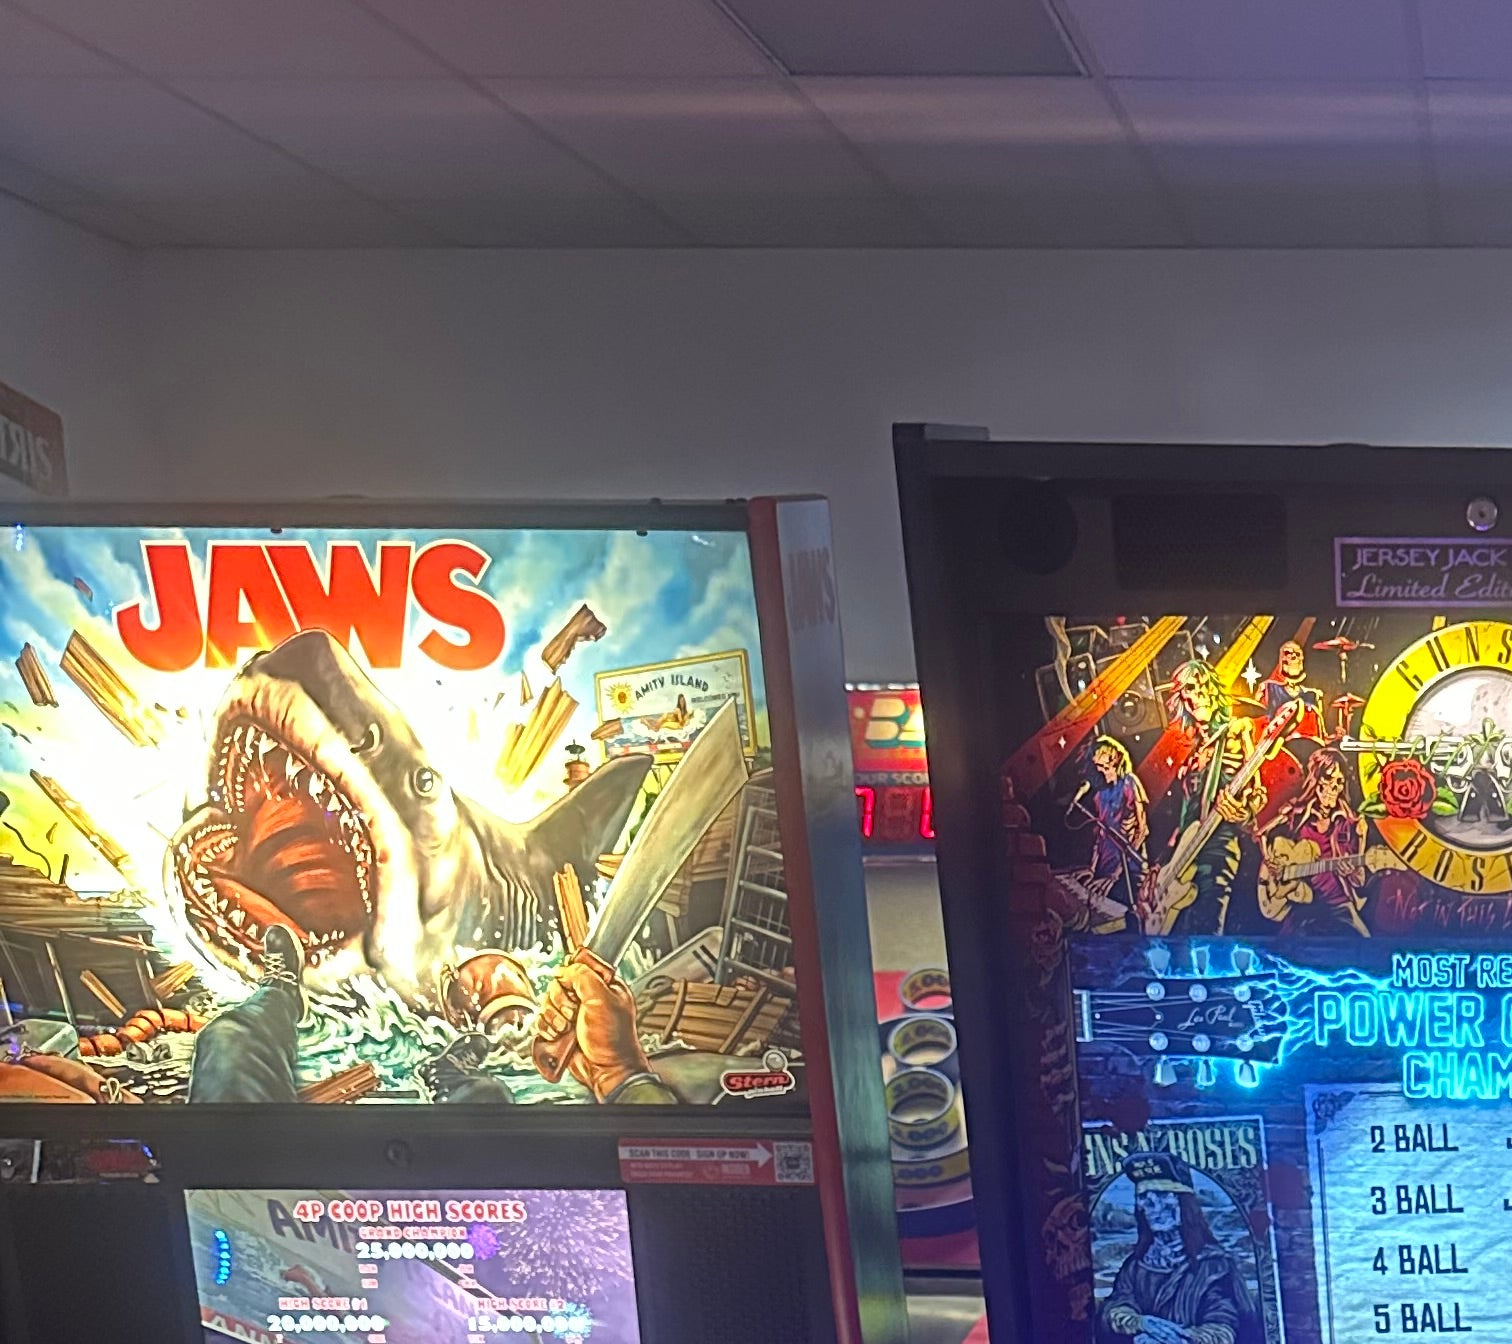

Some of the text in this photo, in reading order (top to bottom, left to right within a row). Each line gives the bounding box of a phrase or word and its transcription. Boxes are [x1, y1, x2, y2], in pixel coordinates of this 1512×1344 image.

[1352, 548, 1440, 570] JERSEY
[1441, 548, 1506, 570] JACK
[1346, 572, 1449, 599] Limited
[114, 538, 508, 672] JAWS
[635, 673, 710, 702] AMITY ISLAND
[1392, 953, 1470, 988] MOST
[1314, 991, 1486, 1047] POWER
[1370, 1125, 1386, 1153] 2
[1394, 1123, 1460, 1152] BALL
[293, 1200, 527, 1223] 4P COOP HIGH SCORES
[1370, 1186, 1387, 1215] 3
[1396, 1183, 1464, 1214] BALL
[1372, 1246, 1388, 1275] 4
[1398, 1243, 1469, 1275] BALL
[1373, 1303, 1391, 1334] 5
[1401, 1302, 1472, 1333] BALL
